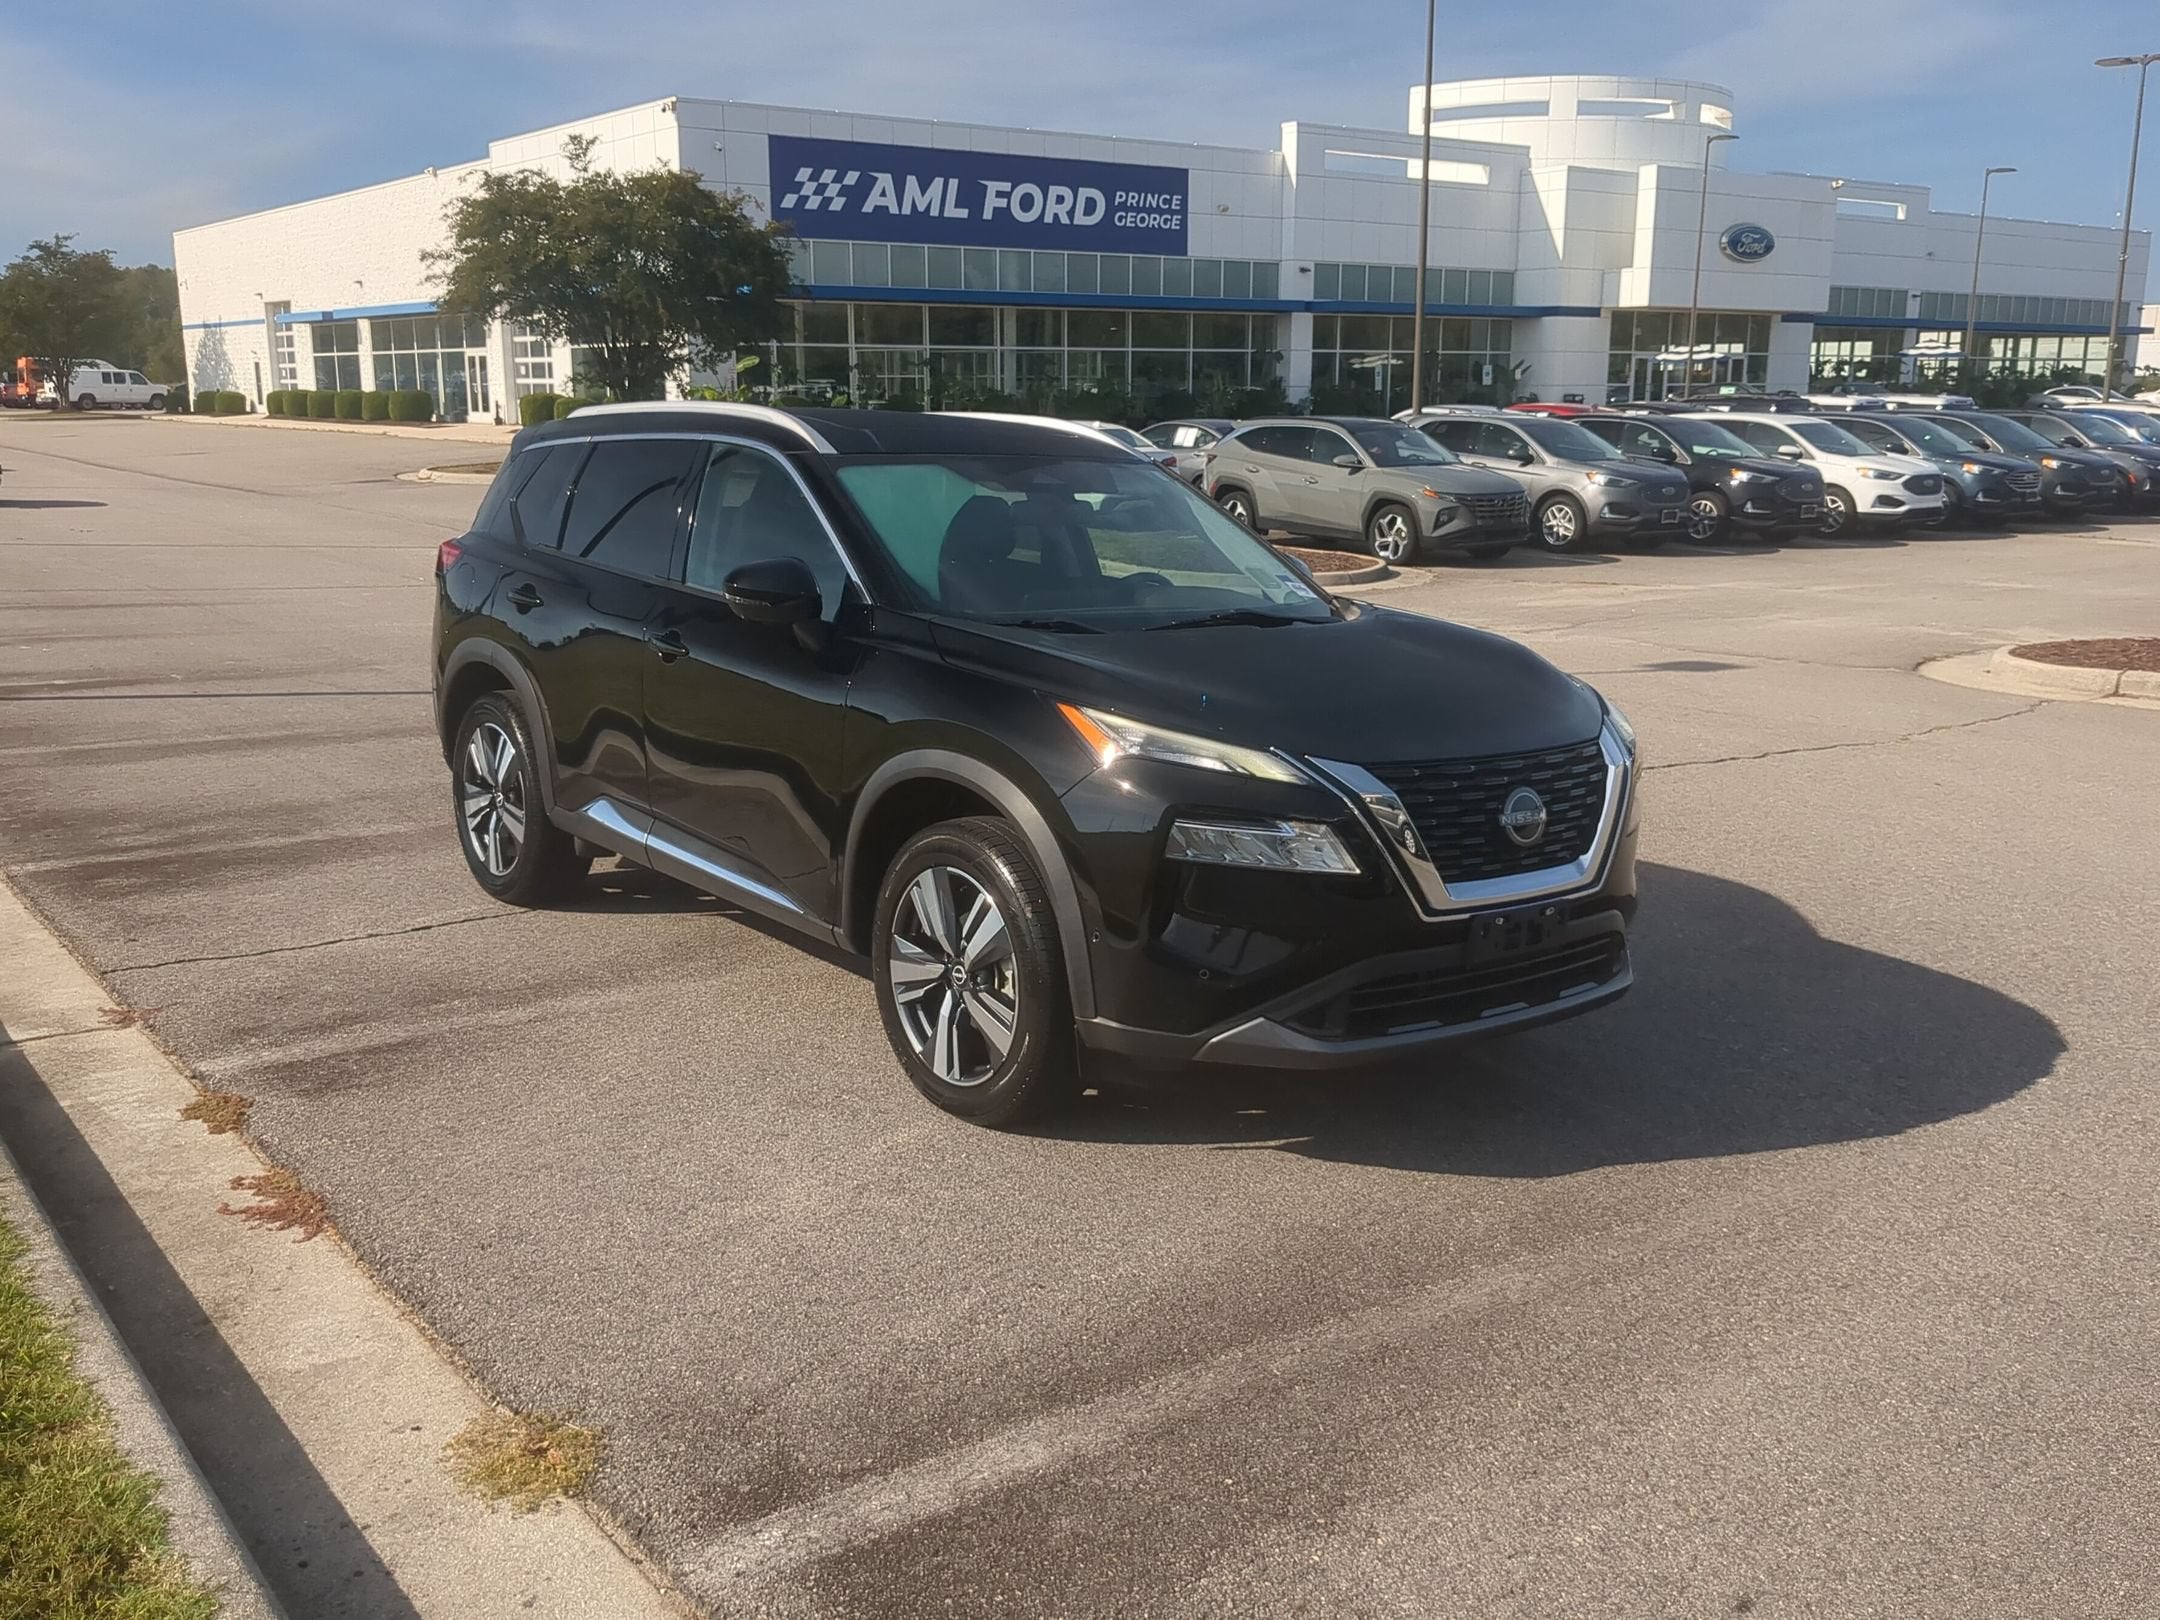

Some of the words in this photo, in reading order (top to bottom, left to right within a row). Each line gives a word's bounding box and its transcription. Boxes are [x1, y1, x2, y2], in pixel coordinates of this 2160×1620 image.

[860, 171, 969, 219] AML
[977, 180, 1106, 226] FORD
[1114, 191, 1182, 209] PRINCE
[1114, 211, 1181, 229] GEORGE
[1737, 232, 1767, 253] Ford
